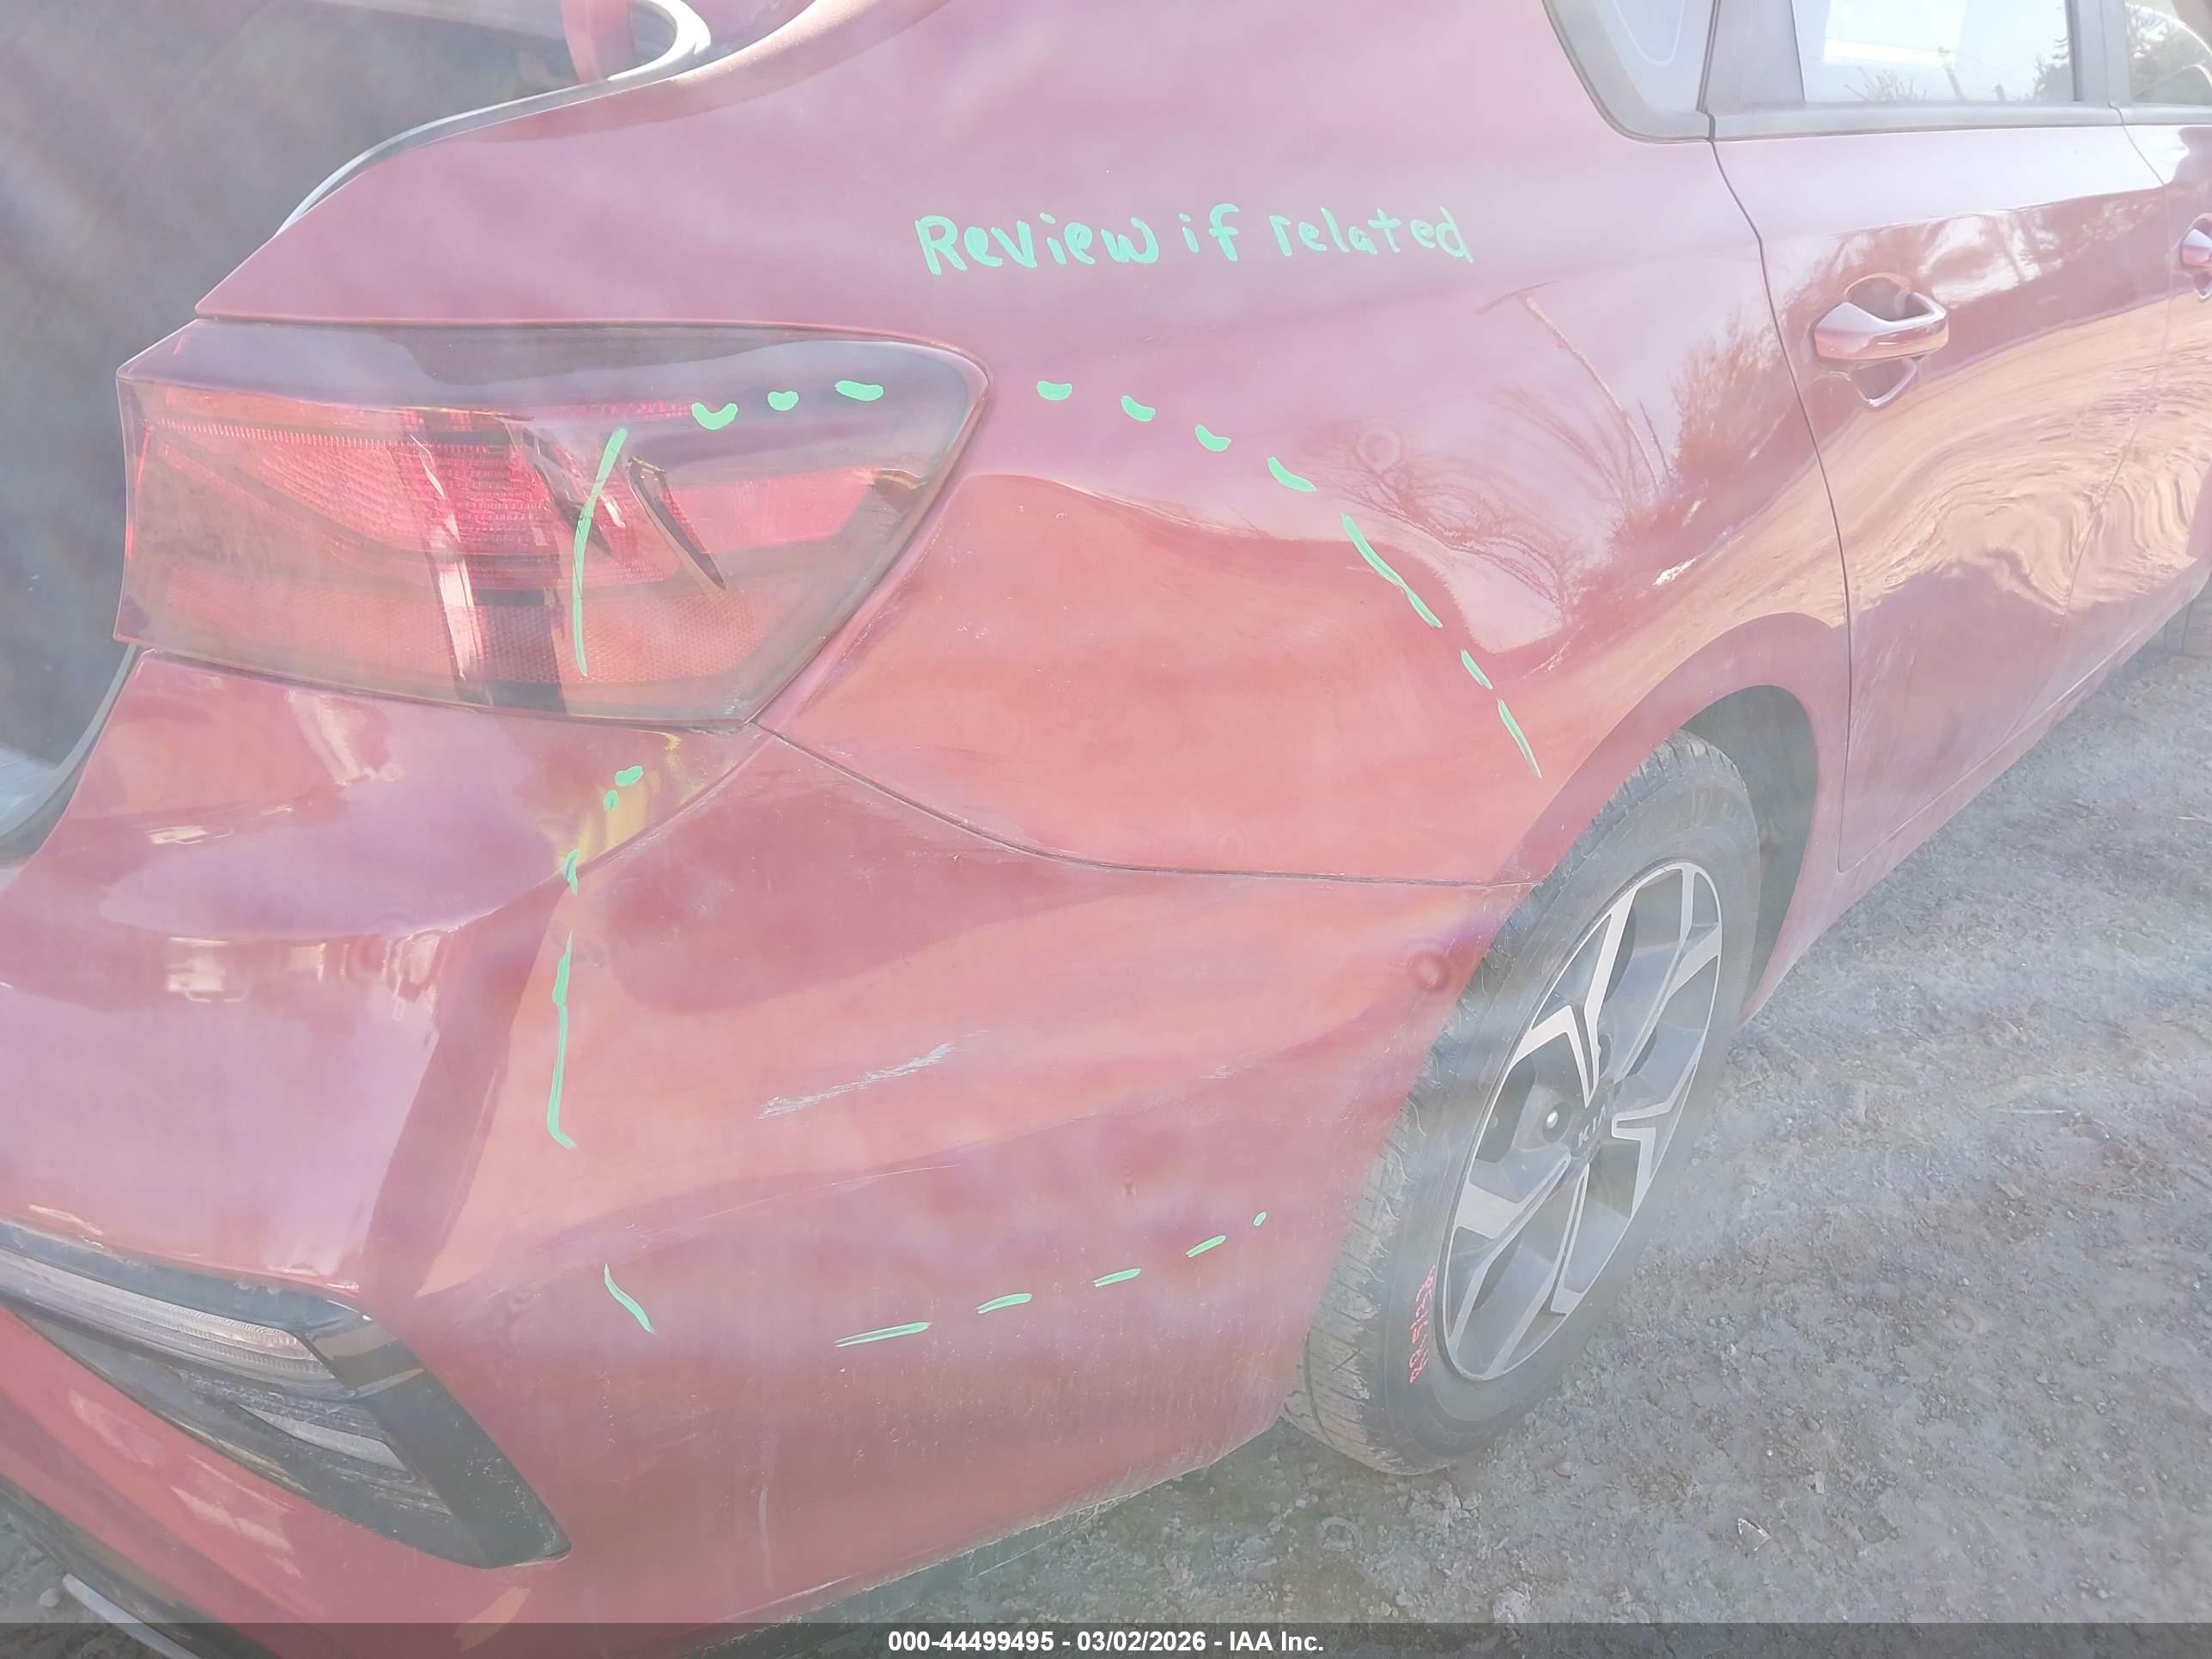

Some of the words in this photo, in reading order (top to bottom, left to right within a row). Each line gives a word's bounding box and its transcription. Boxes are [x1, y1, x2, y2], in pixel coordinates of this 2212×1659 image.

[915, 215, 1159, 275] Review
[1179, 203, 1239, 261] if
[1269, 206, 1474, 263] related
